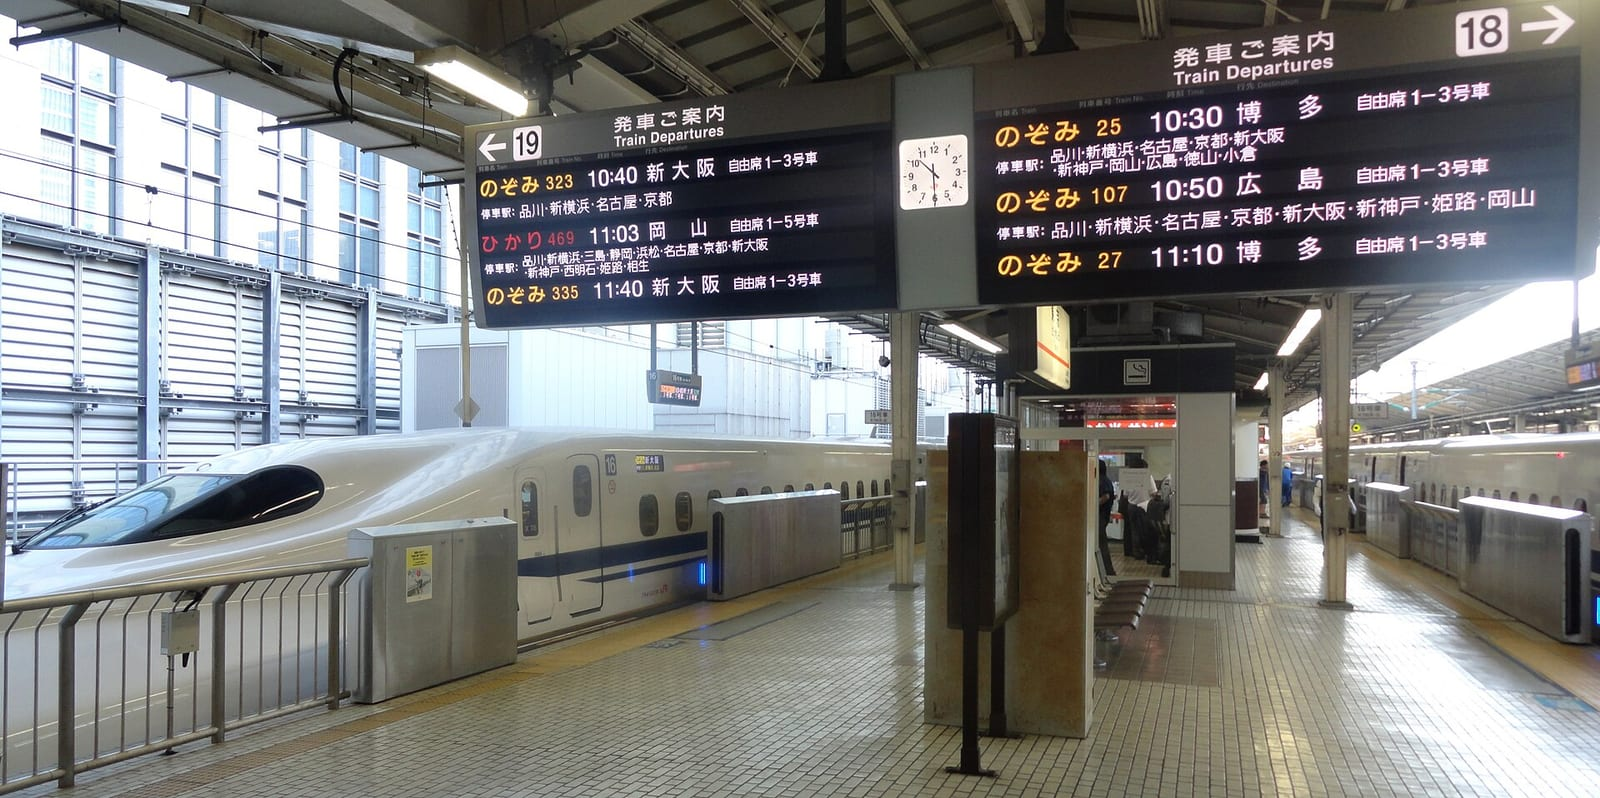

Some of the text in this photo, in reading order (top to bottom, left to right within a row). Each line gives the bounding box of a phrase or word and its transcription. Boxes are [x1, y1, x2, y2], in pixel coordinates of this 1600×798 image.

[1460, 15, 1503, 50] 18
[1173, 30, 1335, 68] 発車ご案内
[1173, 56, 1334, 86] Train Departures
[613, 105, 725, 134] 発車ご案内
[995, 120, 1080, 148] のぞみ
[1096, 118, 1122, 137] 25
[1150, 105, 1223, 133] 10:30
[516, 130, 539, 156] 19
[613, 125, 724, 148] Train Departures
[919, 150, 926, 158] 11
[930, 145, 939, 154] 12
[952, 155, 958, 164] 2
[911, 159, 920, 168] 10
[955, 168, 961, 176] 3
[480, 175, 540, 198] のぞみ
[545, 174, 574, 190] 323
[588, 166, 638, 188] 10:40
[908, 172, 914, 181] 9
[911, 183, 917, 191] 8
[952, 180, 958, 188] 4
[920, 192, 926, 200] 7
[944, 189, 950, 198] 5
[996, 187, 1081, 213] のぞみ
[1091, 185, 1128, 204] 107
[1150, 176, 1223, 202] 10:50
[481, 231, 542, 253] ひかり
[548, 230, 575, 246] 469
[589, 224, 640, 245] 11:03
[998, 252, 1082, 276] のぞみ
[1098, 251, 1122, 269] 27
[1151, 243, 1223, 268] 11:10
[487, 285, 546, 305] のぞみ
[552, 285, 579, 300] 335
[594, 280, 643, 299] 11:40
[606, 456, 616, 473] 16
